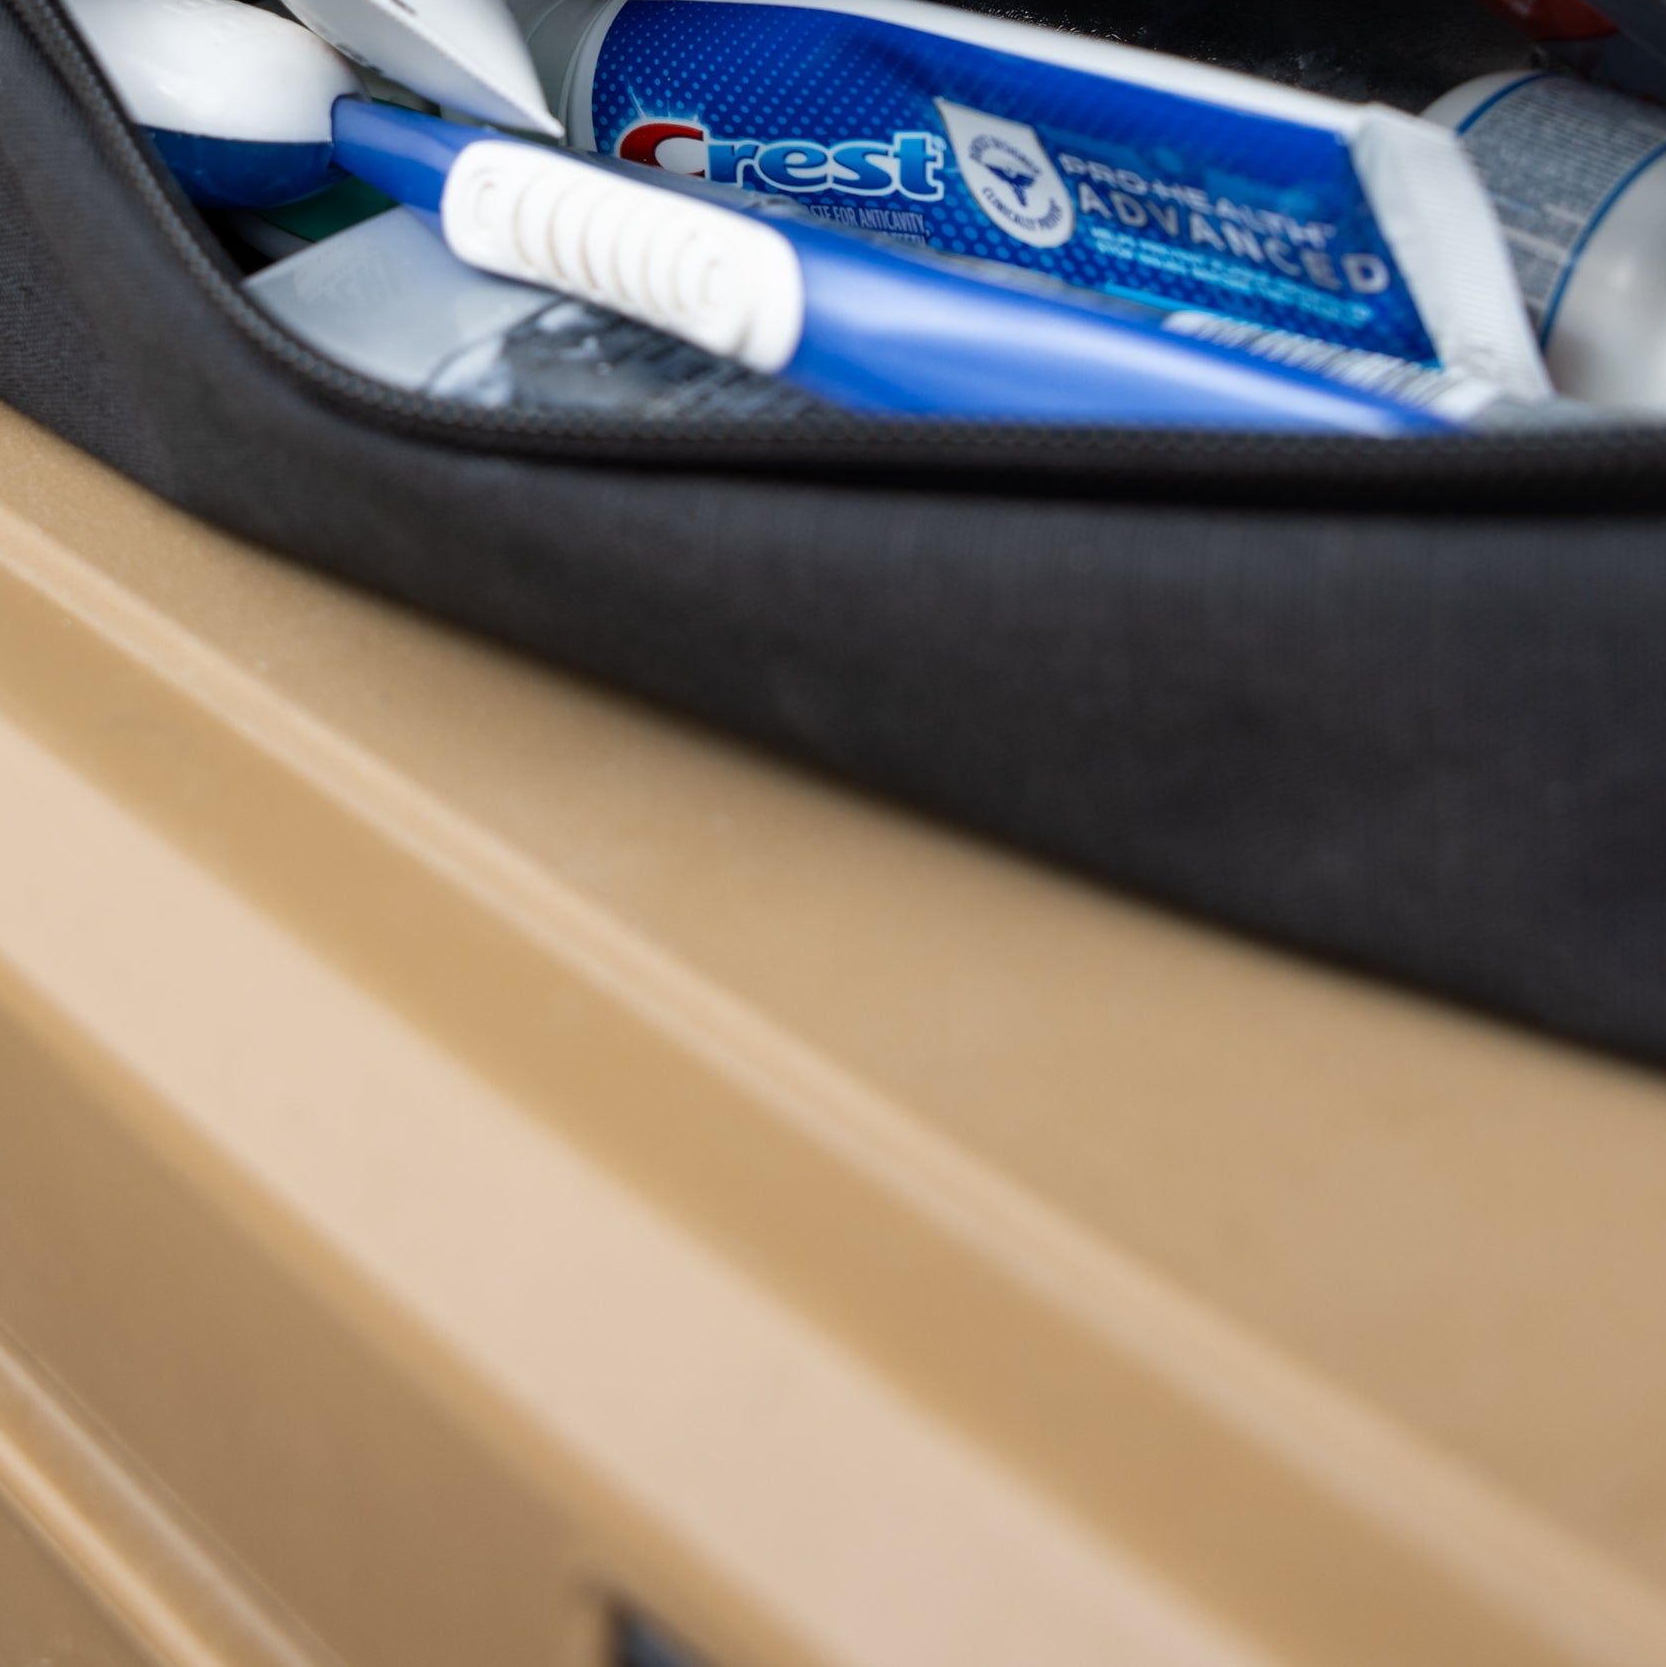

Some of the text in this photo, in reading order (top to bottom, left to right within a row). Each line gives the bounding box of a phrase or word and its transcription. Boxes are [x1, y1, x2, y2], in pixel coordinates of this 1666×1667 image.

[616, 120, 945, 202] Crest
[833, 205, 858, 226] FOR
[858, 208, 931, 237] ANTICAVITY,
[1078, 181, 1391, 295] ADVANCED
